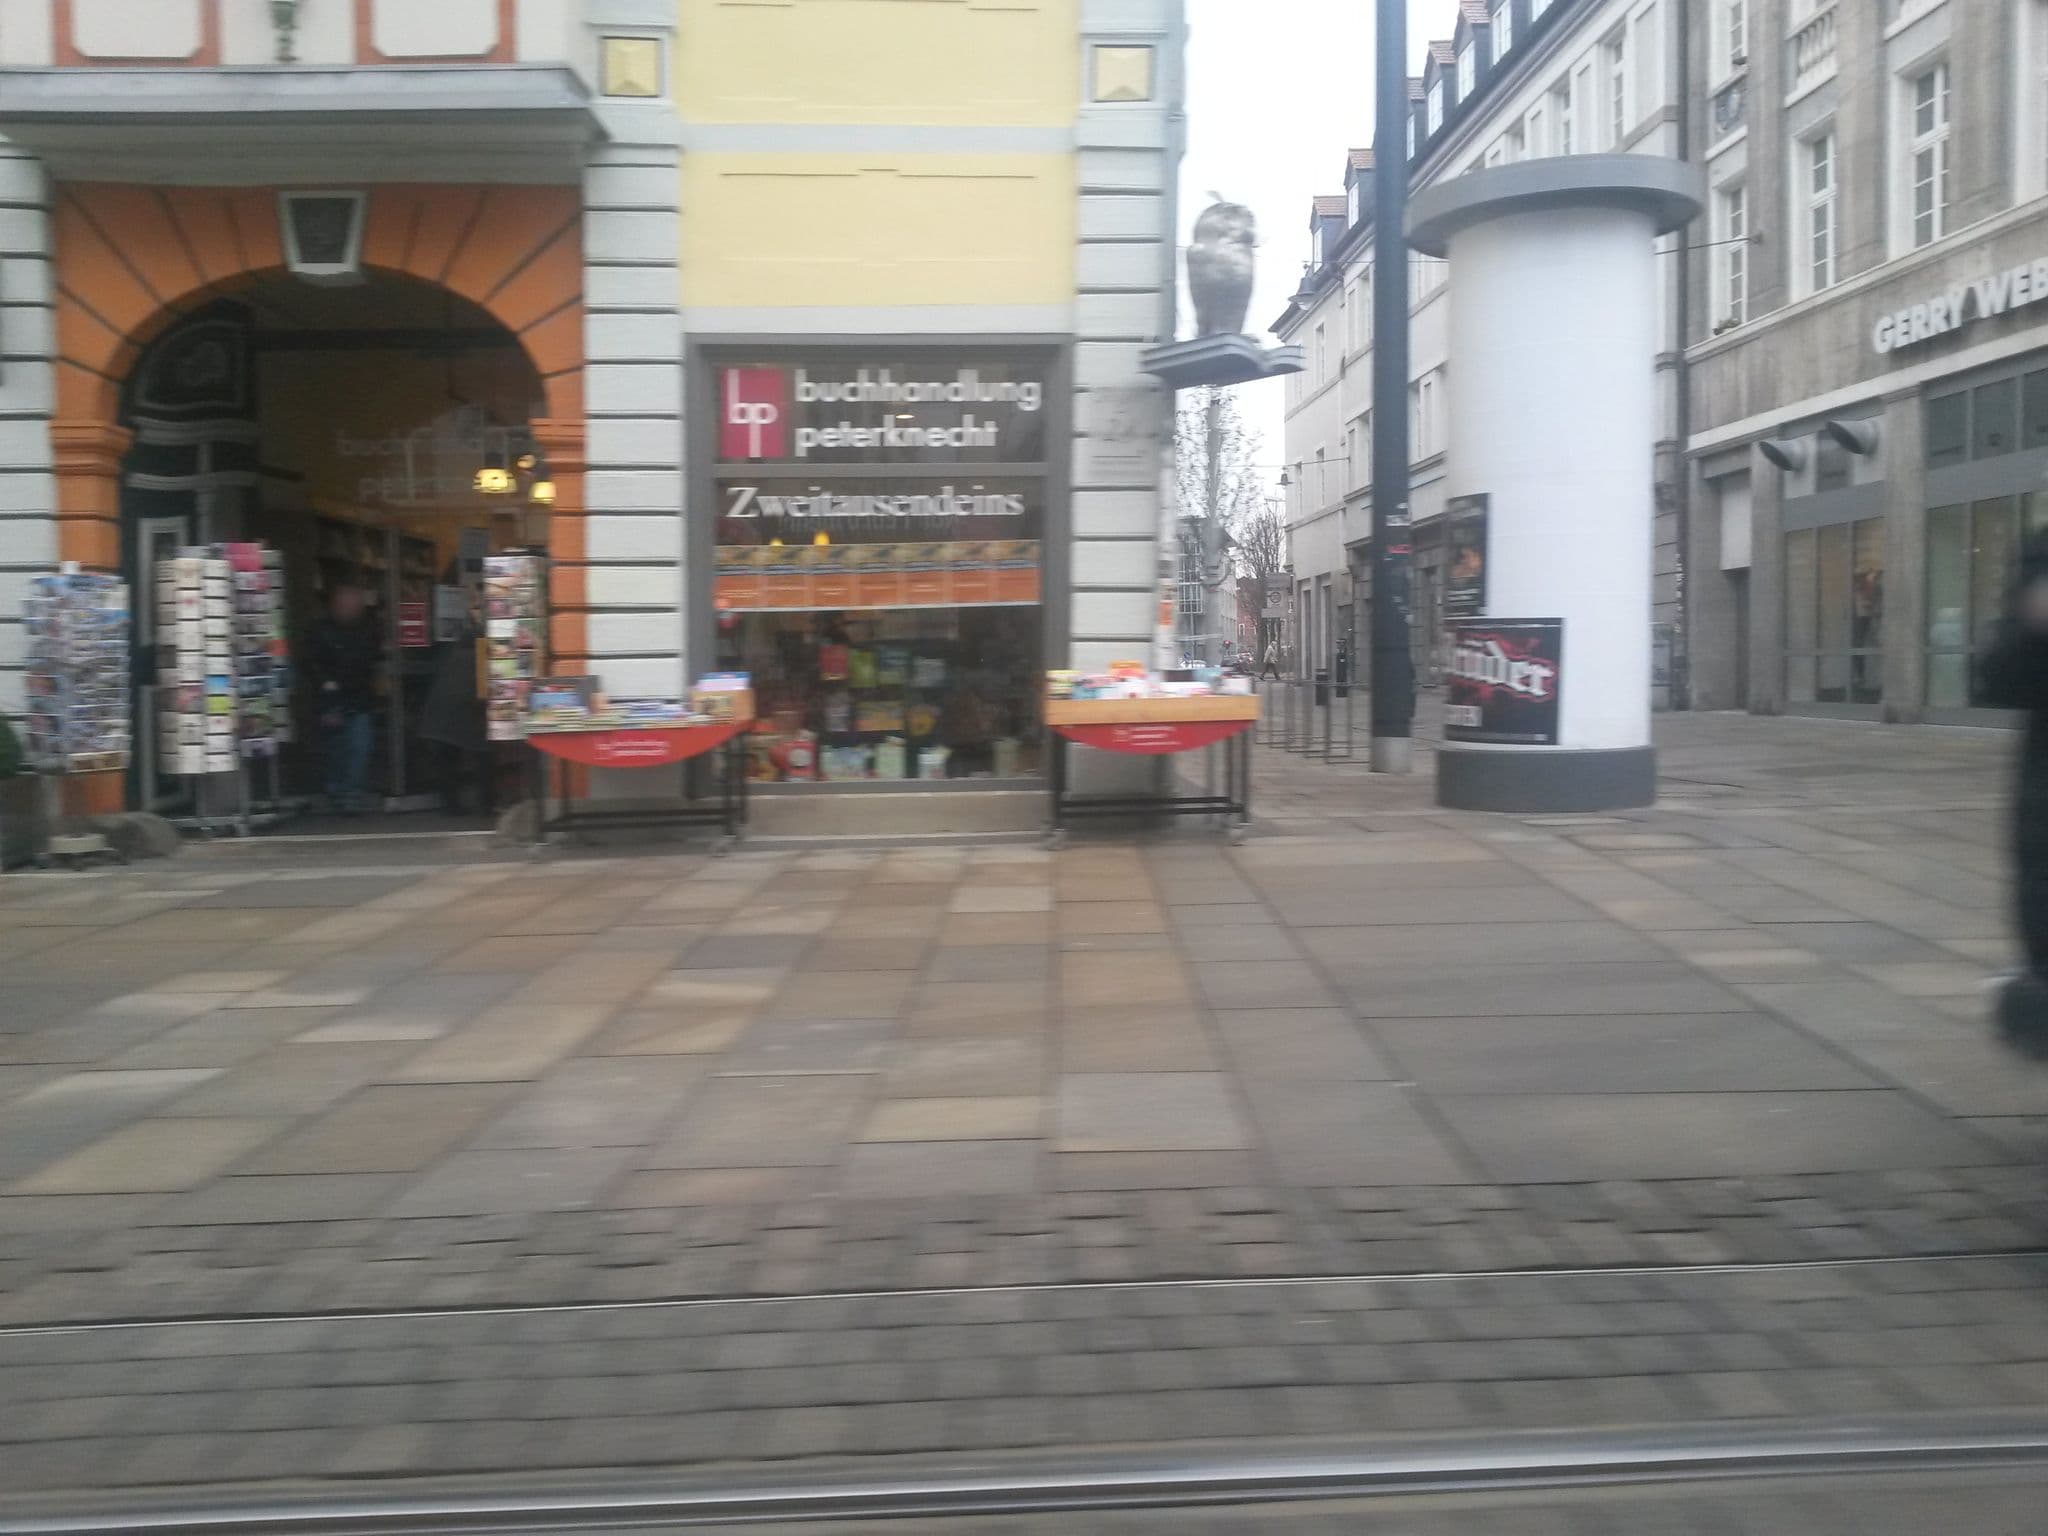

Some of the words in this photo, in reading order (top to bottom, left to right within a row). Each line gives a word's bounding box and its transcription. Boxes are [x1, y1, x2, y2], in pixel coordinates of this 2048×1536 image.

[1873, 282, 1967, 353] GERRY
[795, 368, 1042, 411] buchhandlung
[726, 368, 778, 458] bp
[795, 414, 1000, 458] peterknecht
[726, 485, 1025, 517] Zweitausendeins
